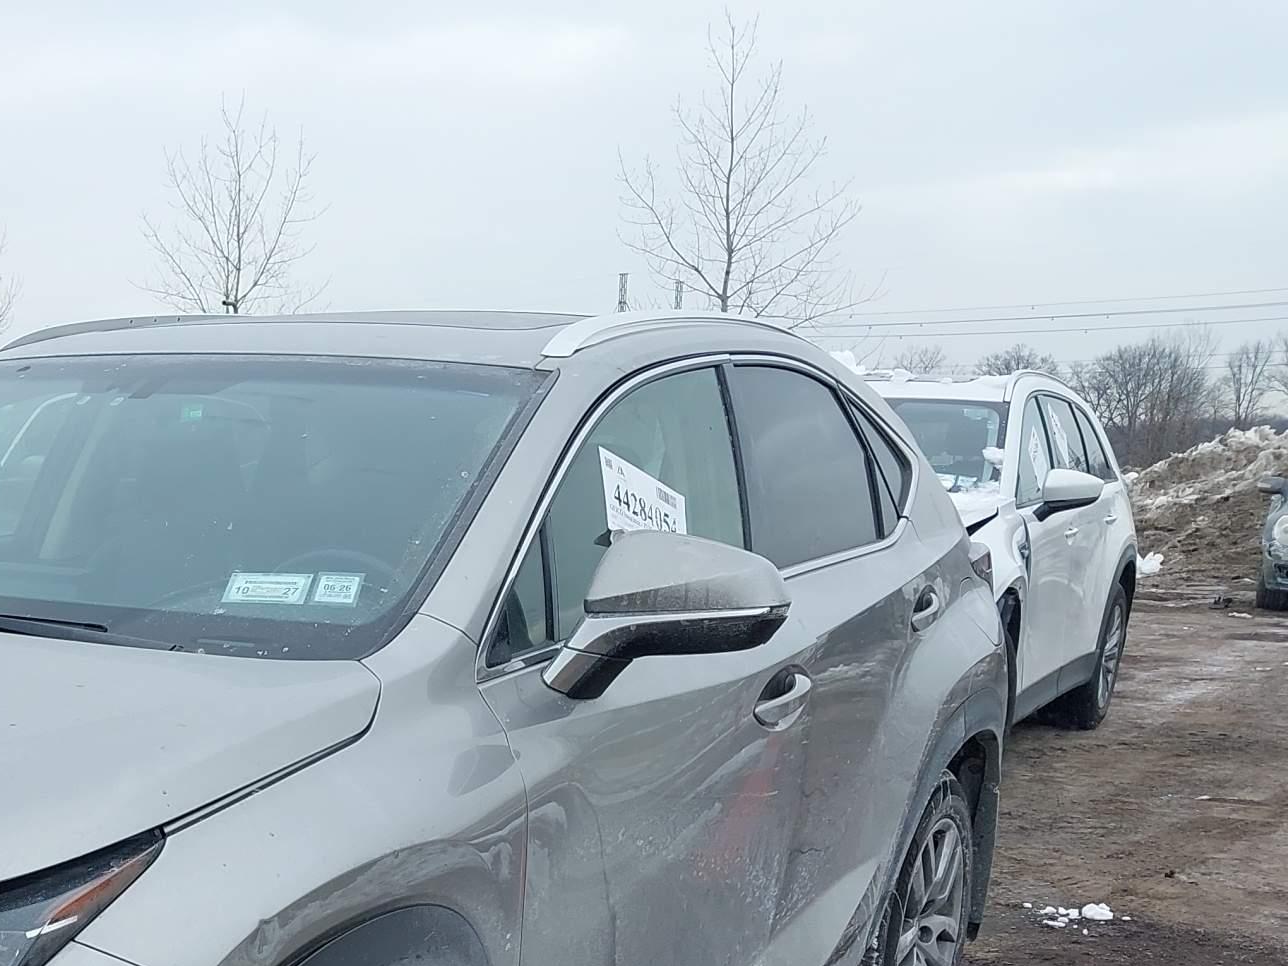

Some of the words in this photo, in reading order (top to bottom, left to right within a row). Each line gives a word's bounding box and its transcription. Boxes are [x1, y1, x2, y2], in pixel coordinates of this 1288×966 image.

[614, 484, 677, 533] 44284054
[234, 586, 250, 594] 10
[282, 587, 300, 596] 27
